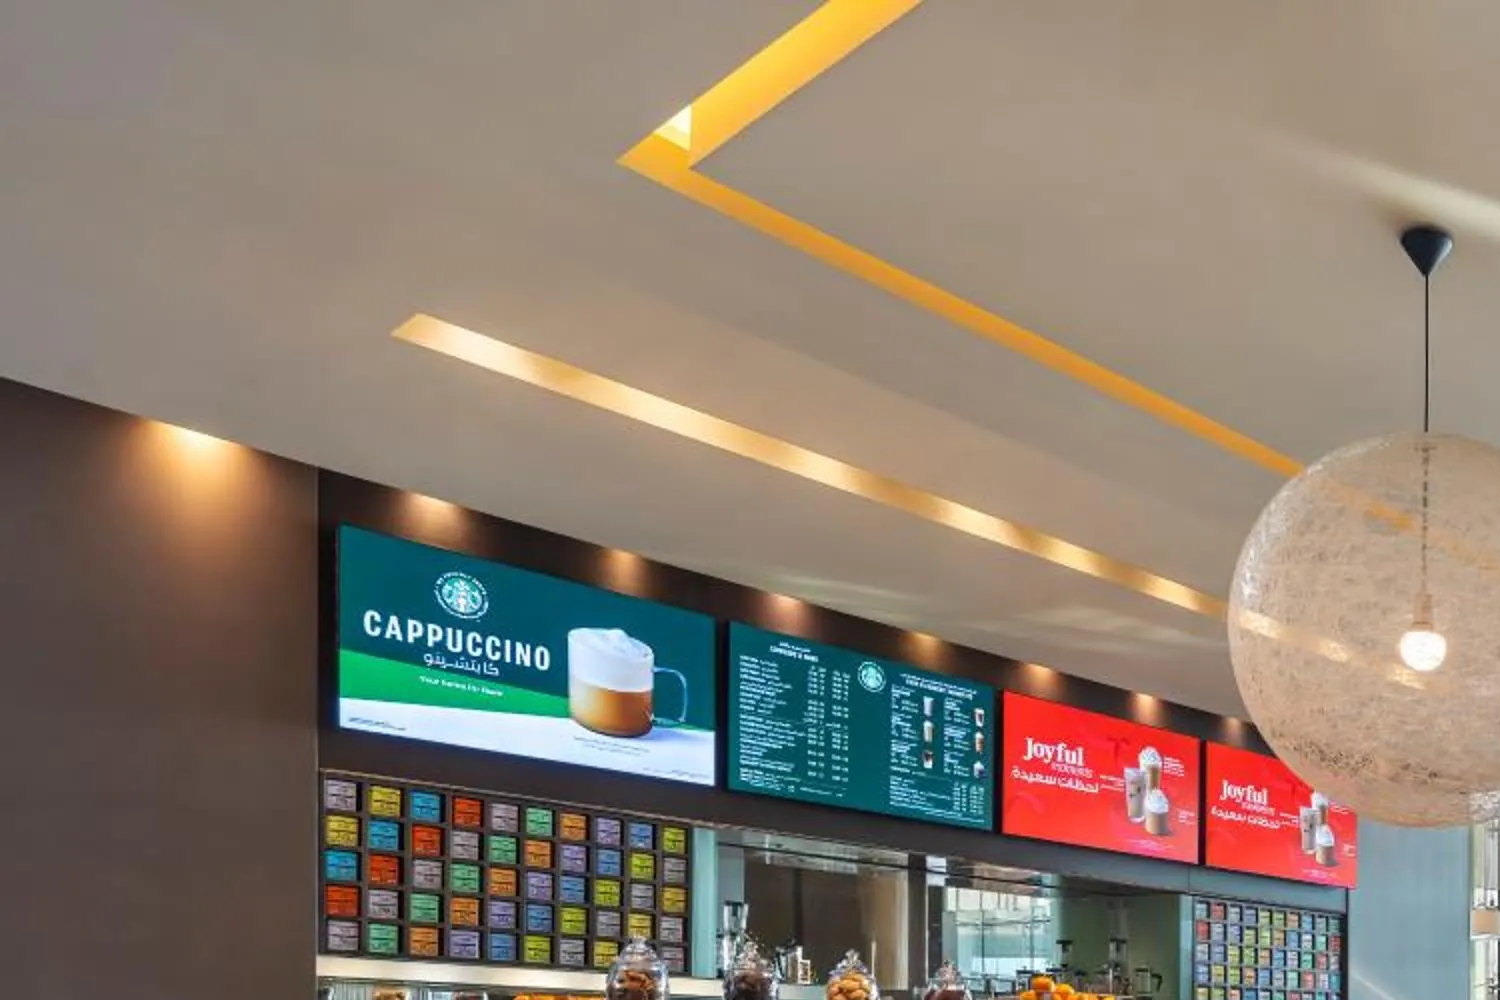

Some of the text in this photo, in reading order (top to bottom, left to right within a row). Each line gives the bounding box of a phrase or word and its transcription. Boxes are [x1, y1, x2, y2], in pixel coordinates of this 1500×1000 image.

[363, 609, 550, 671] CAPPUCCINO
[1023, 737, 1084, 767] Joyful
[1219, 779, 1269, 805] Joyful
